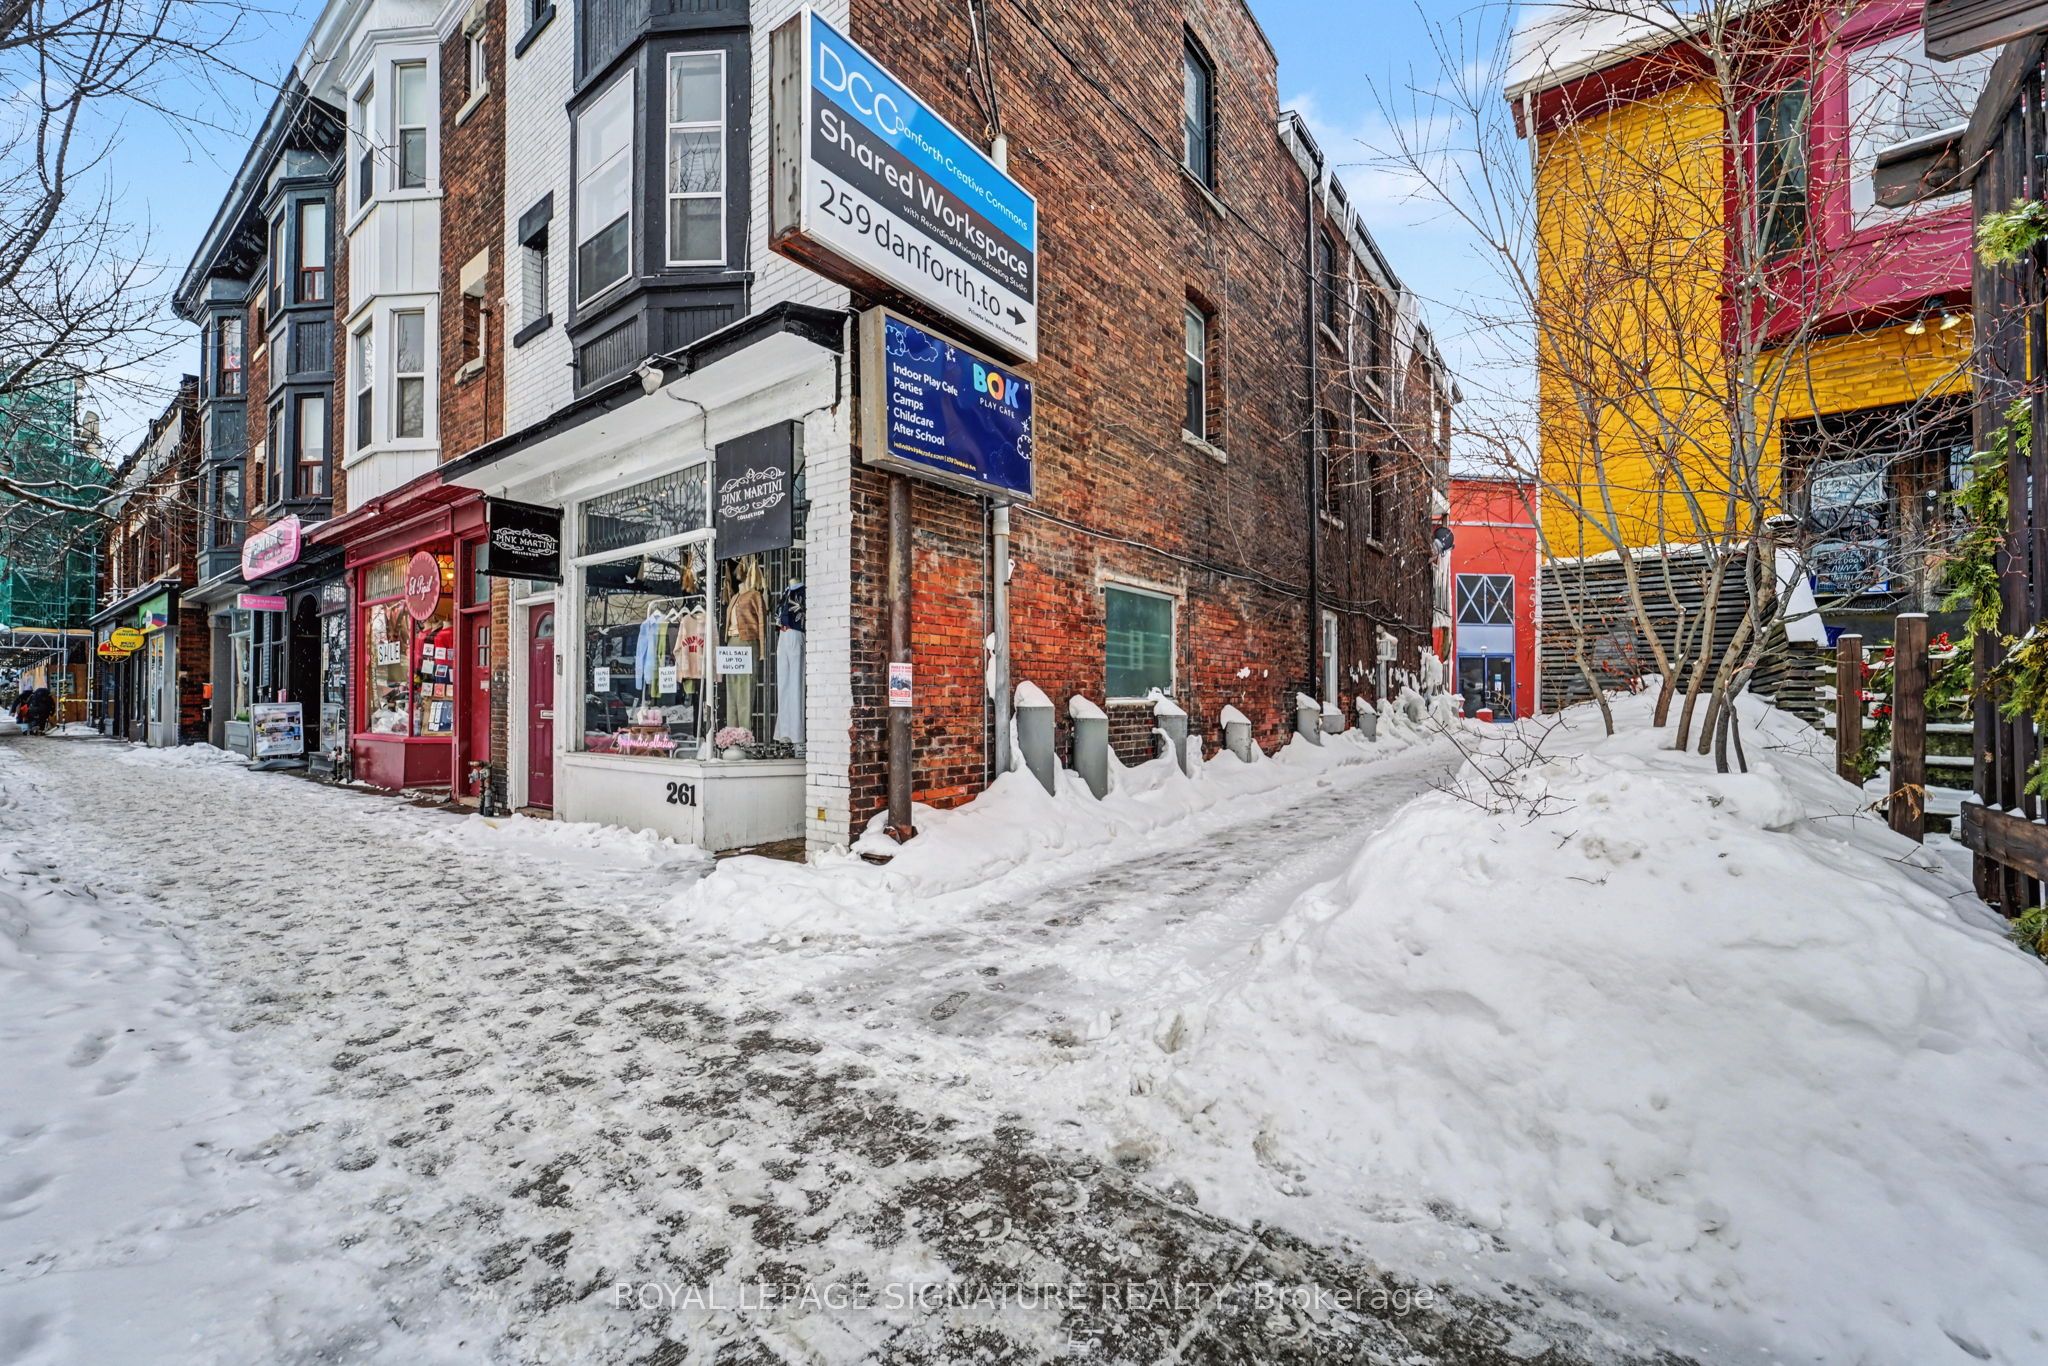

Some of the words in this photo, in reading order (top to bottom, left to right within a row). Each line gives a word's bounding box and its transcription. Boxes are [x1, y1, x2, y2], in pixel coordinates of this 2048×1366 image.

[820, 41, 898, 135] DCC
[895, 115, 944, 163] Danforth
[945, 158, 985, 197] Creative
[985, 190, 1028, 231] Commons
[820, 108, 914, 199] Shared
[918, 178, 1028, 279] Workspace
[903, 205, 920, 220] with
[1009, 276, 1028, 293] Studio
[893, 362, 922, 381] Indoor
[923, 373, 941, 391] Play
[941, 381, 958, 396] Cafe
[894, 377, 923, 396] Parties
[973, 363, 1020, 409] BOK
[893, 392, 924, 411] Camps
[980, 397, 997, 410] PLAY
[893, 407, 934, 428] Childcare
[893, 422, 914, 437] After
[915, 428, 945, 446] School
[721, 489, 742, 506] PINK
[744, 479, 782, 501] MARTINI
[737, 510, 765, 521] COLLECTION
[496, 534, 517, 544] PINK
[519, 537, 556, 550] MARTINI
[380, 642, 400, 663] SALE
[666, 782, 697, 807] 261
